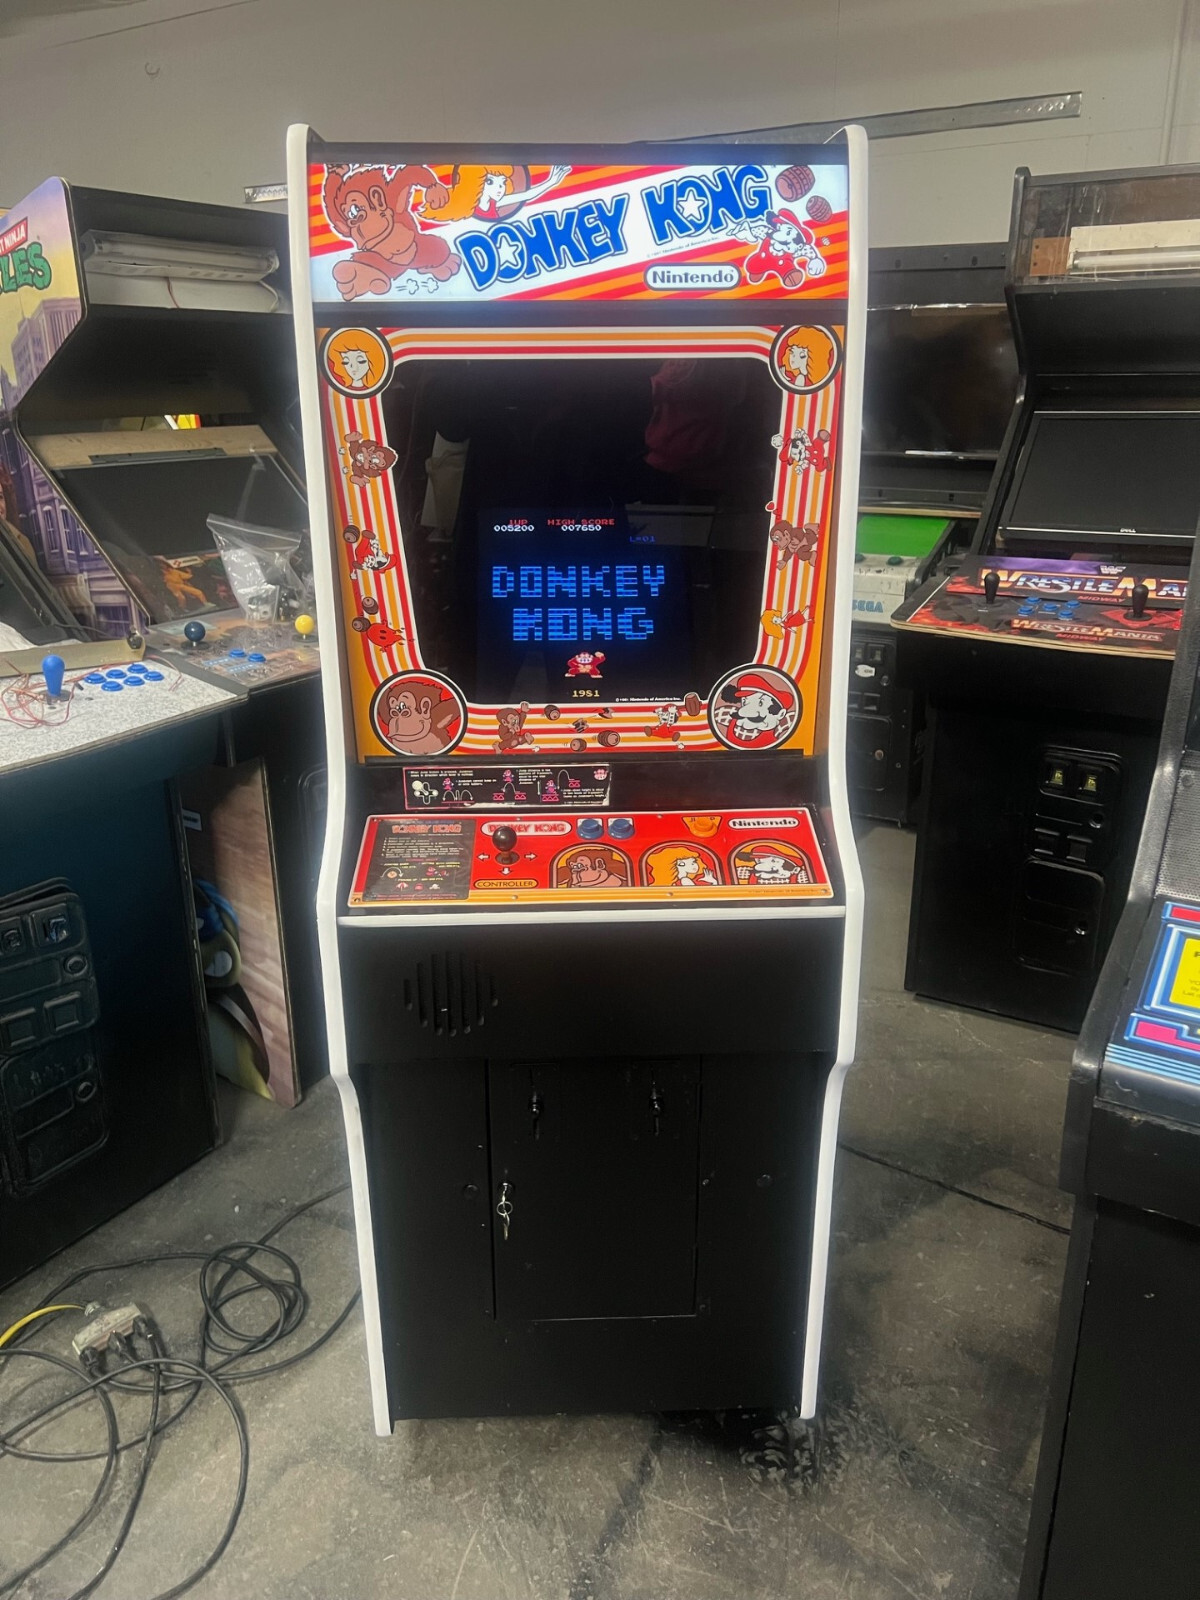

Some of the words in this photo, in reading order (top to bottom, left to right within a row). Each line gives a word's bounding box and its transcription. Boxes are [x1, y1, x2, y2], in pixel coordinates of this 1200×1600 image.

[459, 194, 630, 291] DONKEY
[643, 165, 771, 246] KONG
[651, 269, 735, 285] Nintendo
[509, 518, 528, 526] 1UP
[547, 518, 575, 526] HIGH
[581, 518, 615, 526] SCORE
[493, 524, 535, 532] 005200
[561, 524, 602, 532] 007650
[492, 565, 665, 597] DONKEY
[512, 607, 654, 641] KONG
[572, 689, 600, 698] 1981
[534, 823, 566, 832] KONG
[731, 818, 797, 828] Nintendo
[477, 880, 534, 888] CONTROLLER
